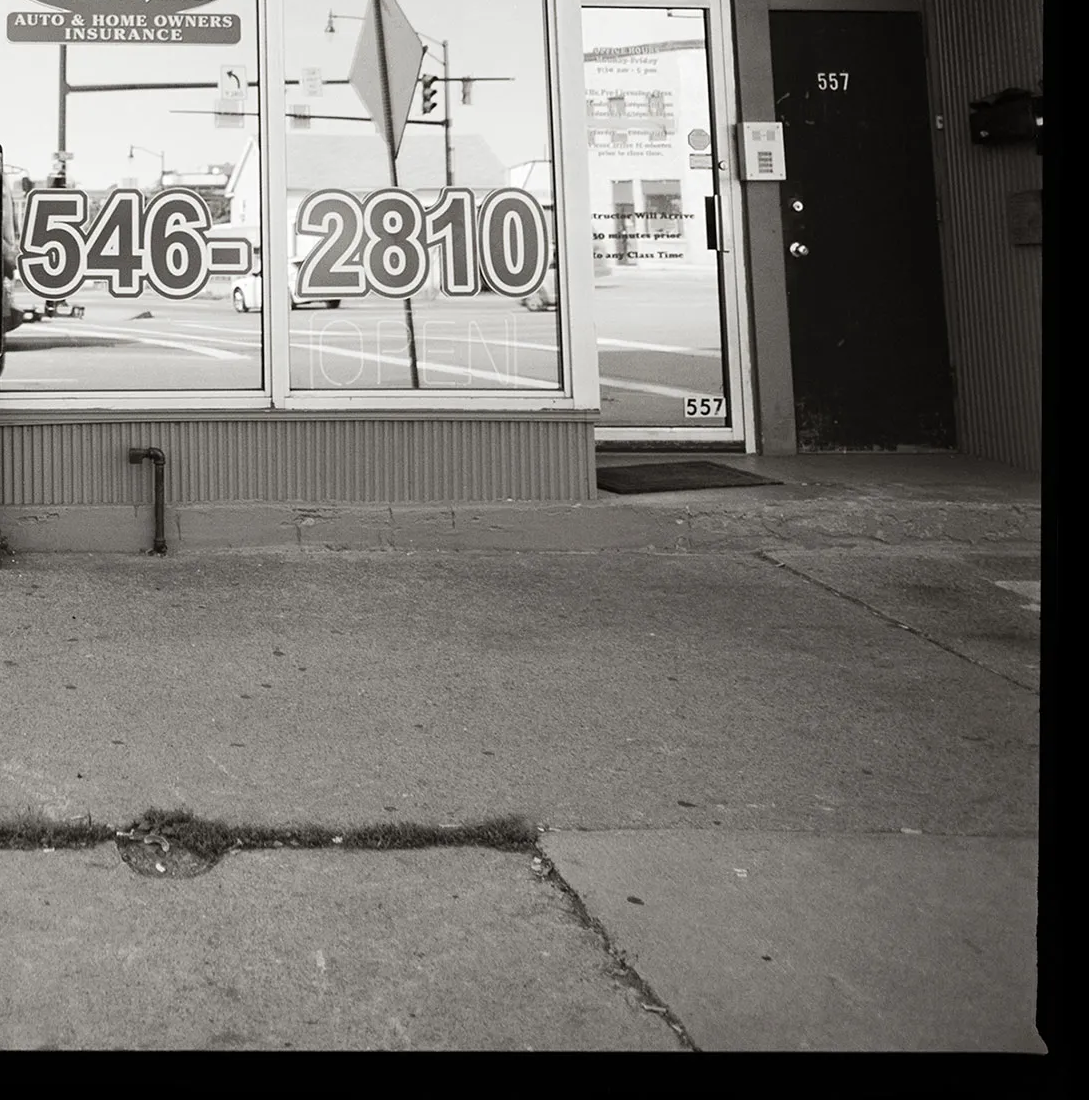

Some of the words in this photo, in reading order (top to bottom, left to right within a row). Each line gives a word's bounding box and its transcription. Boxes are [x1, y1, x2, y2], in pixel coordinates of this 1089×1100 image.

[14, 13, 65, 27] AUTO
[70, 14, 86, 27] &
[92, 14, 148, 27] HOME
[154, 15, 233, 28] OWNERS
[64, 28, 183, 41] INSURANCE
[817, 72, 850, 91] 557
[634, 212, 658, 220] Will
[659, 212, 695, 220] Arrive
[17, 187, 253, 300] 546-
[295, 187, 549, 300] 2810
[608, 232, 651, 240] minutes
[654, 232, 683, 240] prior
[627, 251, 655, 259] Class
[657, 251, 684, 259] Time
[319, 318, 511, 387] OPEN
[685, 397, 724, 417] 557
